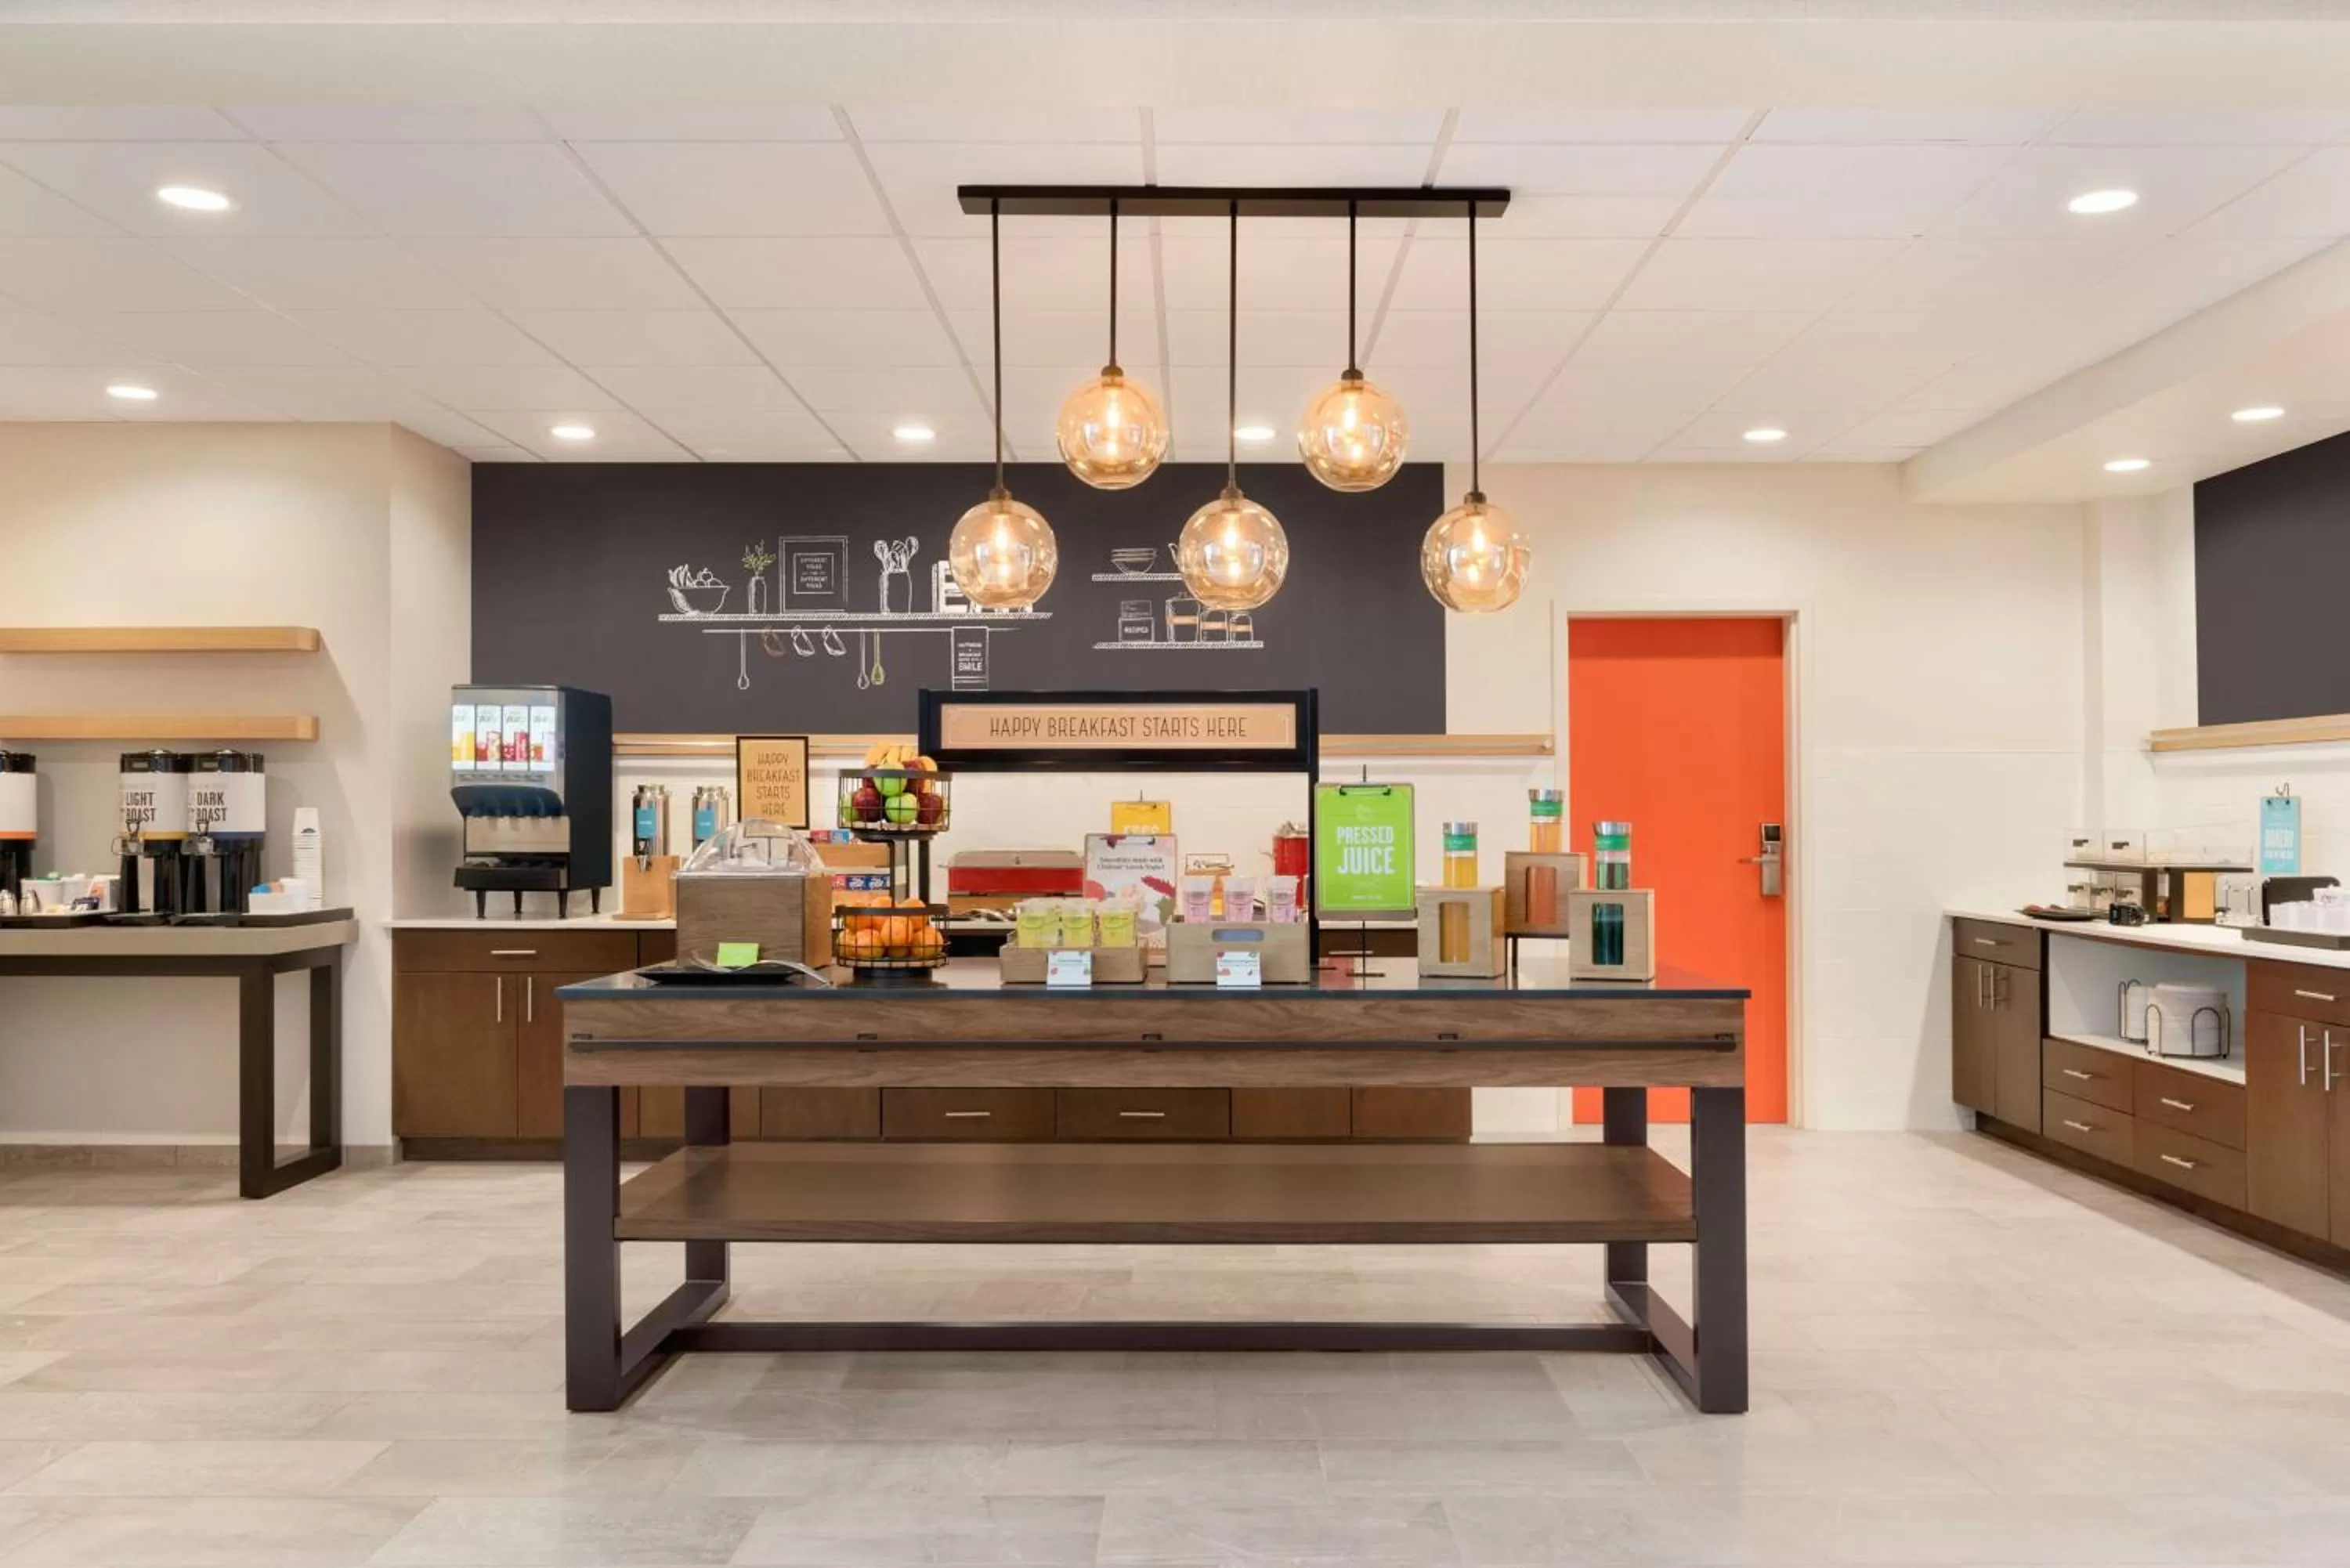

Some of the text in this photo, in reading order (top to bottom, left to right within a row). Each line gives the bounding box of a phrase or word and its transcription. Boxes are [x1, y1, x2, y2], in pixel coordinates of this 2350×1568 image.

[989, 717, 1248, 737] HAPPY BREAKFAST STARTS HERE
[757, 752, 790, 765] HAPPY
[747, 768, 801, 783] BREAKFAST
[125, 792, 154, 806] LIGHT
[197, 792, 226, 806] DARK
[756, 786, 790, 800] STARTS
[125, 807, 157, 822] ROAST
[197, 807, 227, 822] ROAST
[761, 802, 787, 816] HERE
[1336, 826, 1394, 845] PRESSED
[1337, 845, 1397, 876] JUICE
